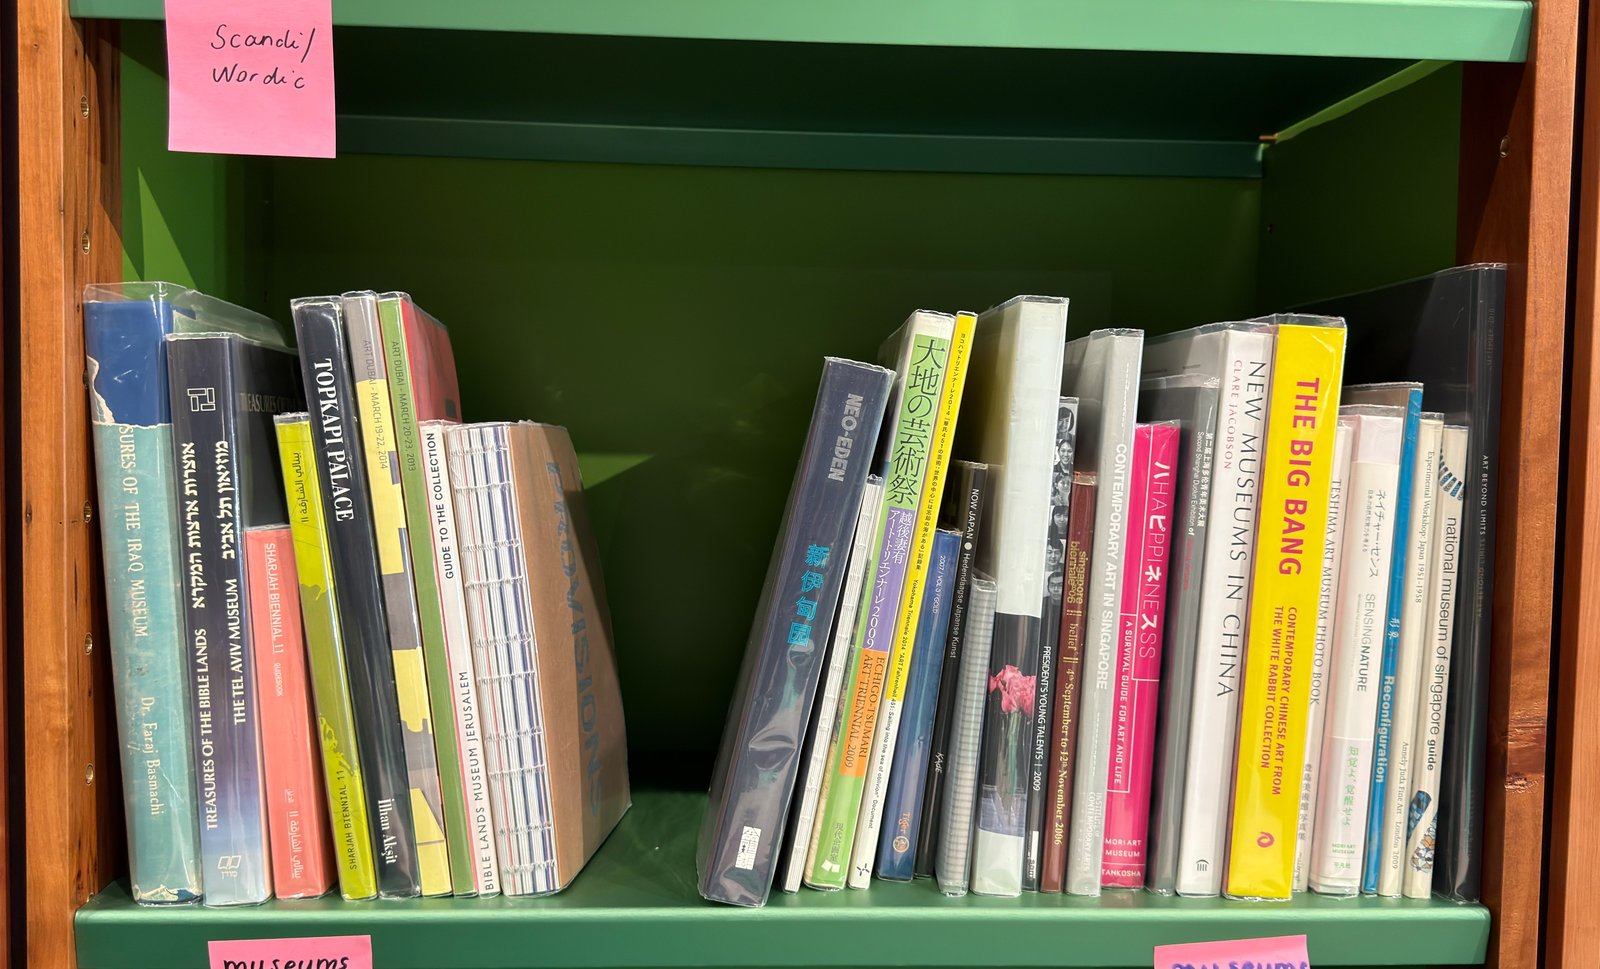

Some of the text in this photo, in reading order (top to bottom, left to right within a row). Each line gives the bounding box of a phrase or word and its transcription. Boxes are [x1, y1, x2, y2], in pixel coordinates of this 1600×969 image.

[362, 339, 373, 362] ART
[365, 362, 376, 387] DUBAI
[392, 341, 401, 361] ART
[394, 361, 406, 387] DUBAI
[370, 392, 383, 426] MARCH
[398, 393, 410, 426] MARCH
[828, 393, 864, 482] NEO-EDEN
[888, 339, 946, 505] 大地の芸術祭
[1223, 359, 1242, 470] CLARE JACOBSON
[313, 358, 354, 522] TOPKAPI PALACE
[378, 451, 388, 470] 2014
[406, 453, 416, 472] 2013
[122, 476, 138, 495] OF
[215, 440, 236, 560] מוזיאון תל אביב
[1279, 377, 1320, 576] THE BIG BANG
[1424, 451, 1435, 498] Experimental
[125, 503, 140, 530] THE
[181, 442, 207, 609] אוצרות ארצות המקרא
[426, 432, 454, 580] GUIDE TO THE COLLECTION
[1188, 527, 1195, 536] of
[1216, 361, 1267, 697] NEW MUSEUMS IN CHINA
[1479, 509, 1487, 535] LIMITS
[127, 538, 144, 572] IRAQ
[892, 512, 914, 565] 越後妻有
[1096, 444, 1127, 689] CONTEMPORARY ART IN SINGAPORE
[1418, 540, 1427, 560] Japan
[266, 543, 285, 654] SHARJAH BIENNIAL 11
[949, 489, 980, 658] NOW JAPAN Hedendaagse Japanse Kunst
[1076, 551, 1089, 605] singapore
[1310, 479, 1342, 705] TESHIMA ART MUSEUM PHOTO BOOK
[1415, 563, 1424, 603] 1951-1958
[131, 579, 148, 637] MUSEUM
[1068, 623, 1079, 651] belief
[225, 579, 246, 725] THE TEL AVIV MUSEUM
[1427, 517, 1457, 771] national museum of singapore guide
[141, 697, 155, 717] Dr.
[845, 655, 874, 768] ART TRIENNIAL 2009
[858, 657, 885, 758] ECHIGO-TSUMARI
[1114, 620, 1133, 785] A SURVIVAL GUIDE FOR ART AND LIFE
[1261, 606, 1284, 769] THE WHITE RABBIT COLLECTION
[1271, 607, 1298, 795] CONTEMPORARY CHINESE ART FROM
[194, 628, 218, 831] TREASURES OF THE BIBLE LANDS
[885, 712, 893, 733] Sailing
[1032, 646, 1052, 791] PRESIDENT'S YOUNG TALENTS 2009
[1375, 676, 1395, 783] Reconfiguration
[146, 758, 164, 816] Basmachi
[459, 671, 494, 891] BIBLE LANDS MUSEUM JERUSALEM
[1053, 683, 1074, 846] September to November 2006
[336, 769, 357, 870] SHARJAH BIENNIAL 11
[868, 800, 878, 829] Document
[1105, 838, 1142, 847] MORI ART
[1395, 821, 1403, 848] London
[1101, 868, 1141, 877] TANKOSHA
[1105, 849, 1140, 857] MUSEUM
